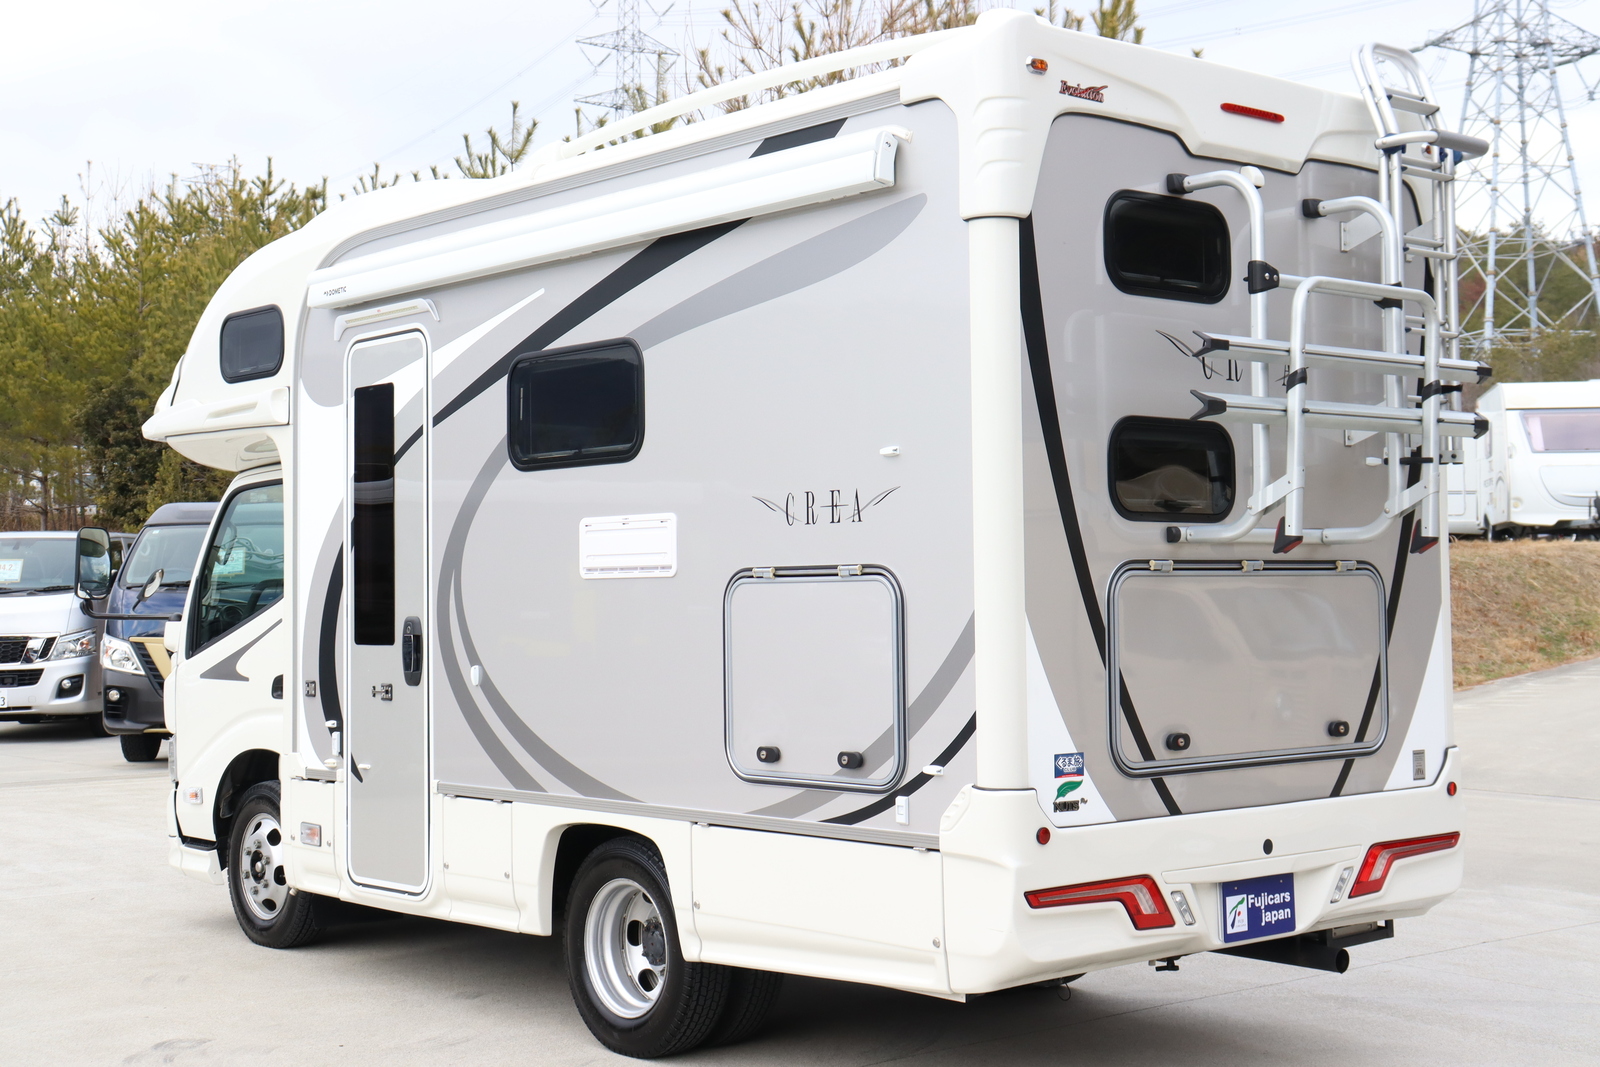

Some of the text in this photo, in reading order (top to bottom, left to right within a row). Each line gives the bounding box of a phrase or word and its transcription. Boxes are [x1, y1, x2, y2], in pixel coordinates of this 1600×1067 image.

[785, 488, 863, 527] CREA
[1248, 892, 1291, 909] Fujicars
[1261, 908, 1291, 926] japan
